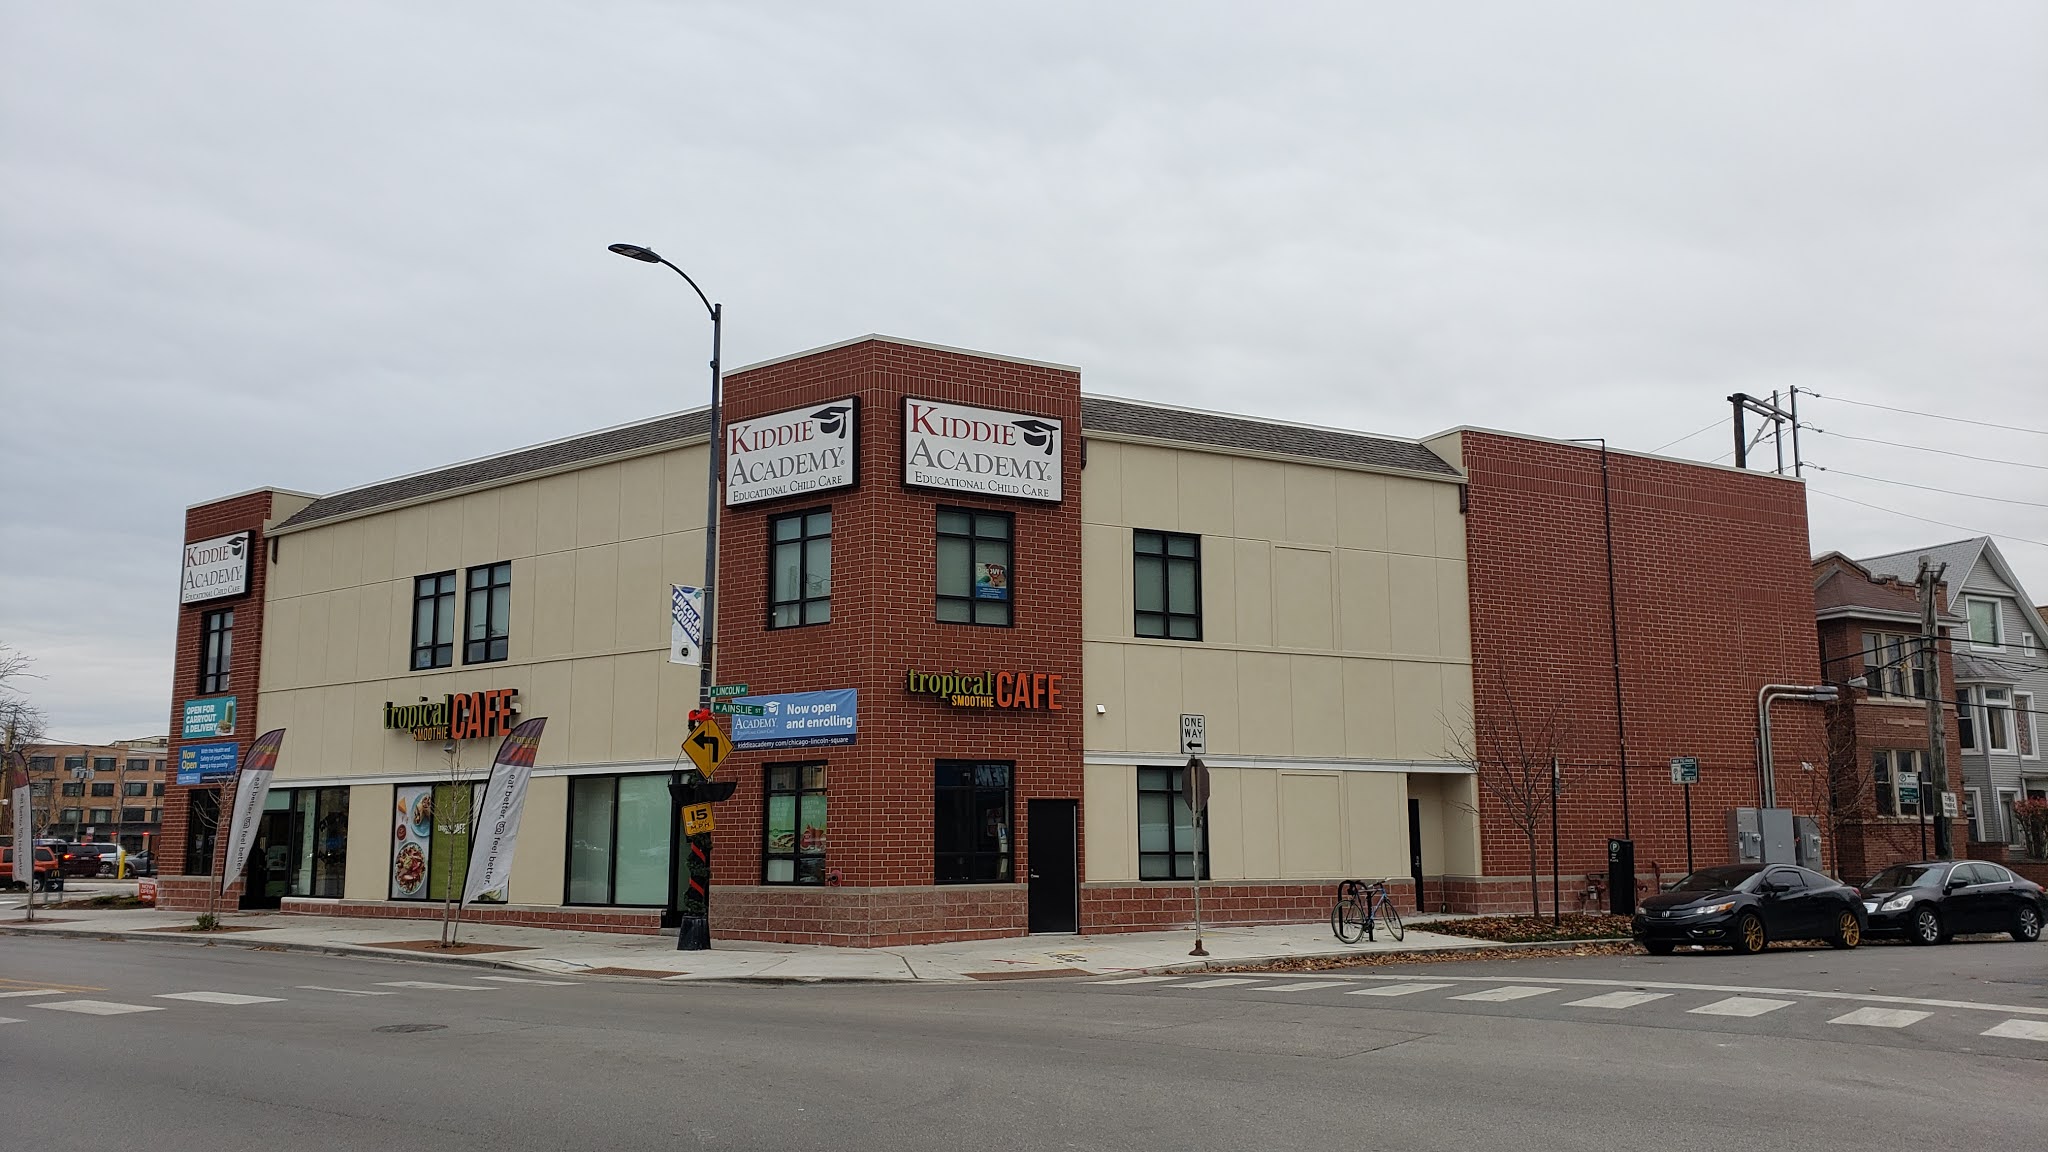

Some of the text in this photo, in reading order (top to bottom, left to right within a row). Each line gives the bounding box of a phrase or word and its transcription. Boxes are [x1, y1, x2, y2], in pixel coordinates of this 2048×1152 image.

[909, 404, 1016, 446] KIDDIE
[730, 420, 814, 456] KIDDIE
[734, 476, 842, 502] EDUCATIONAL CHILD CARE
[915, 471, 1050, 497] EDUCATIONAL CHILD CARE
[186, 546, 229, 568] KIDDIE
[214, 588, 227, 596] CHILD
[228, 585, 240, 593] CARE
[672, 592, 700, 630] LINCOLN
[672, 606, 700, 642] SQUARE
[716, 686, 740, 695] LINCOLN
[908, 669, 994, 698] tropical
[996, 672, 1062, 710] CAFE
[952, 695, 994, 708] SMOOTHIE
[186, 705, 214, 714] OPEN FOR
[383, 694, 449, 734] tropical
[451, 688, 513, 740] CAFE
[722, 704, 752, 714] AINSLIE
[787, 704, 836, 715] Now open
[186, 714, 216, 724] CARRYOUT
[786, 715, 853, 729] and enrolling
[1185, 717, 1202, 727] ONE
[190, 723, 218, 732] DELIVERY
[414, 726, 448, 740] SMOOTHIE
[1185, 728, 1202, 738] WAY
[182, 750, 196, 759] Now
[182, 760, 197, 771] Open
[246, 791, 258, 816] better.
[691, 809, 708, 821] 15
[484, 774, 515, 884] eat better. feel better.
[236, 847, 245, 872] better.
